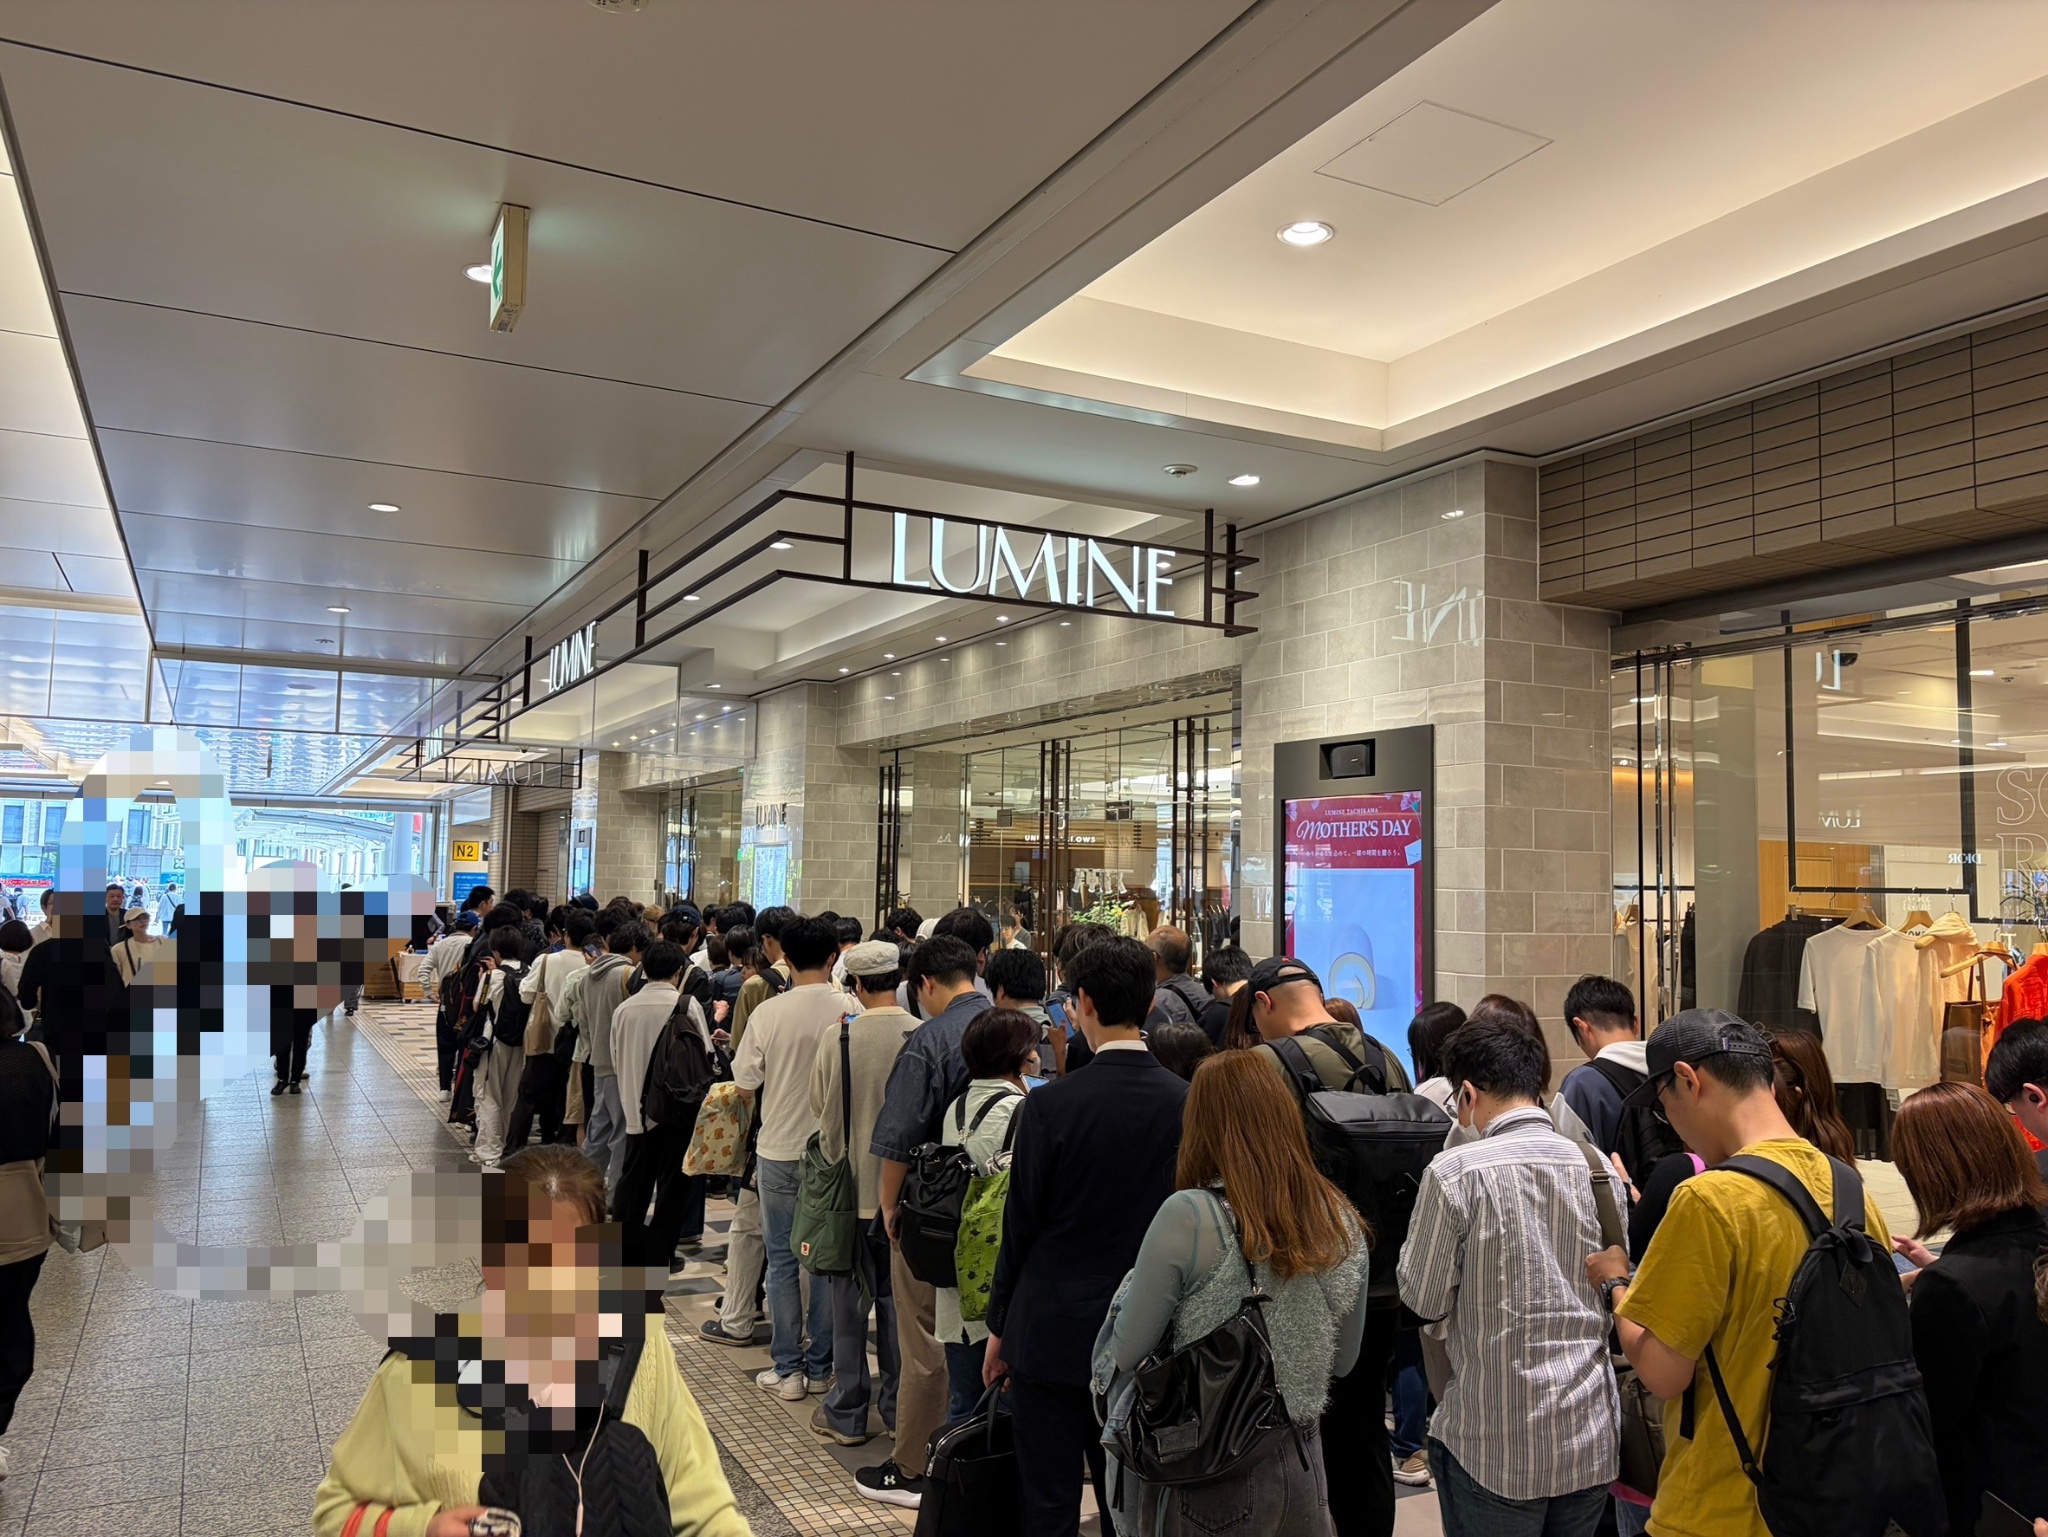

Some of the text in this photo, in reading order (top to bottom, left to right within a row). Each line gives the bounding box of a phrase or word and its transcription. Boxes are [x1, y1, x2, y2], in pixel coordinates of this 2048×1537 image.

[893, 511, 1176, 617] LUMINE
[548, 620, 597, 694] LUMINE
[1346, 806, 1379, 815] TACHIKAWA
[1996, 765, 2048, 826] S
[1296, 819, 1412, 840] MOTHER'S DAY
[456, 845, 474, 857] N2
